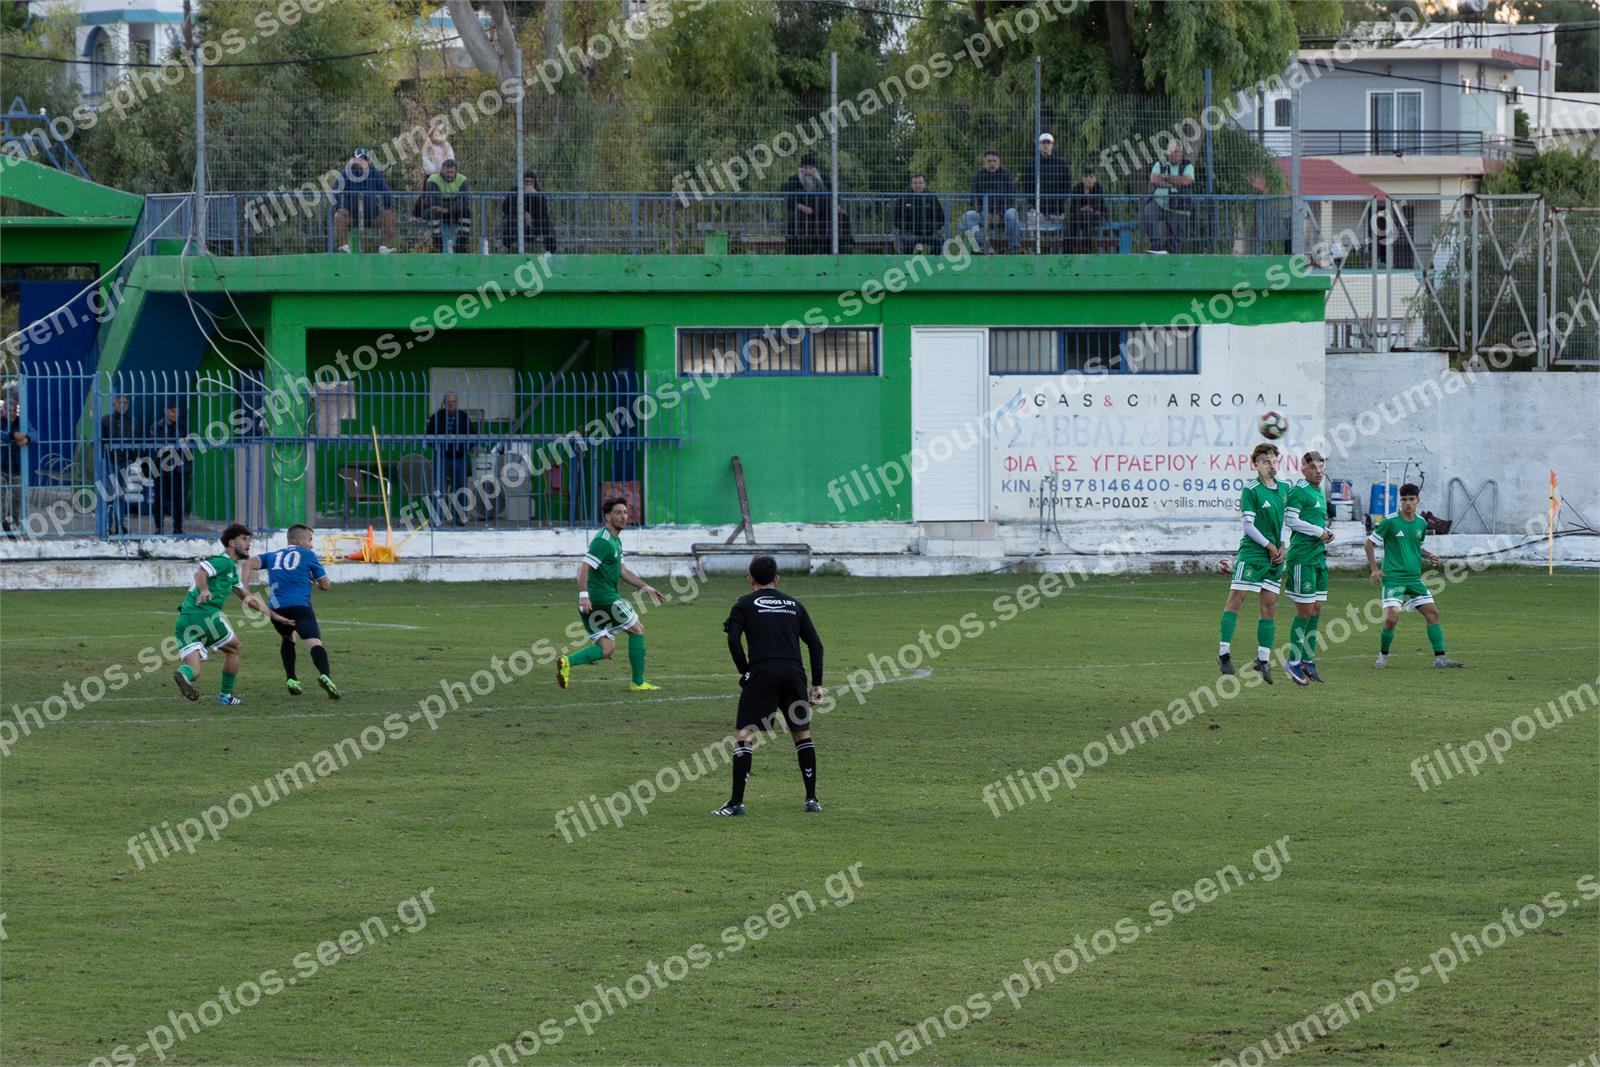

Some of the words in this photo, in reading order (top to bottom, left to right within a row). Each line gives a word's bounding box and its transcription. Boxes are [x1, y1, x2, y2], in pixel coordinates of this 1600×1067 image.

[1167, 414, 1313, 447] ΒΑΣΙΛΣ
[1004, 455, 1078, 472] ΦΙΑΕΣ
[271, 550, 301, 571] 10
